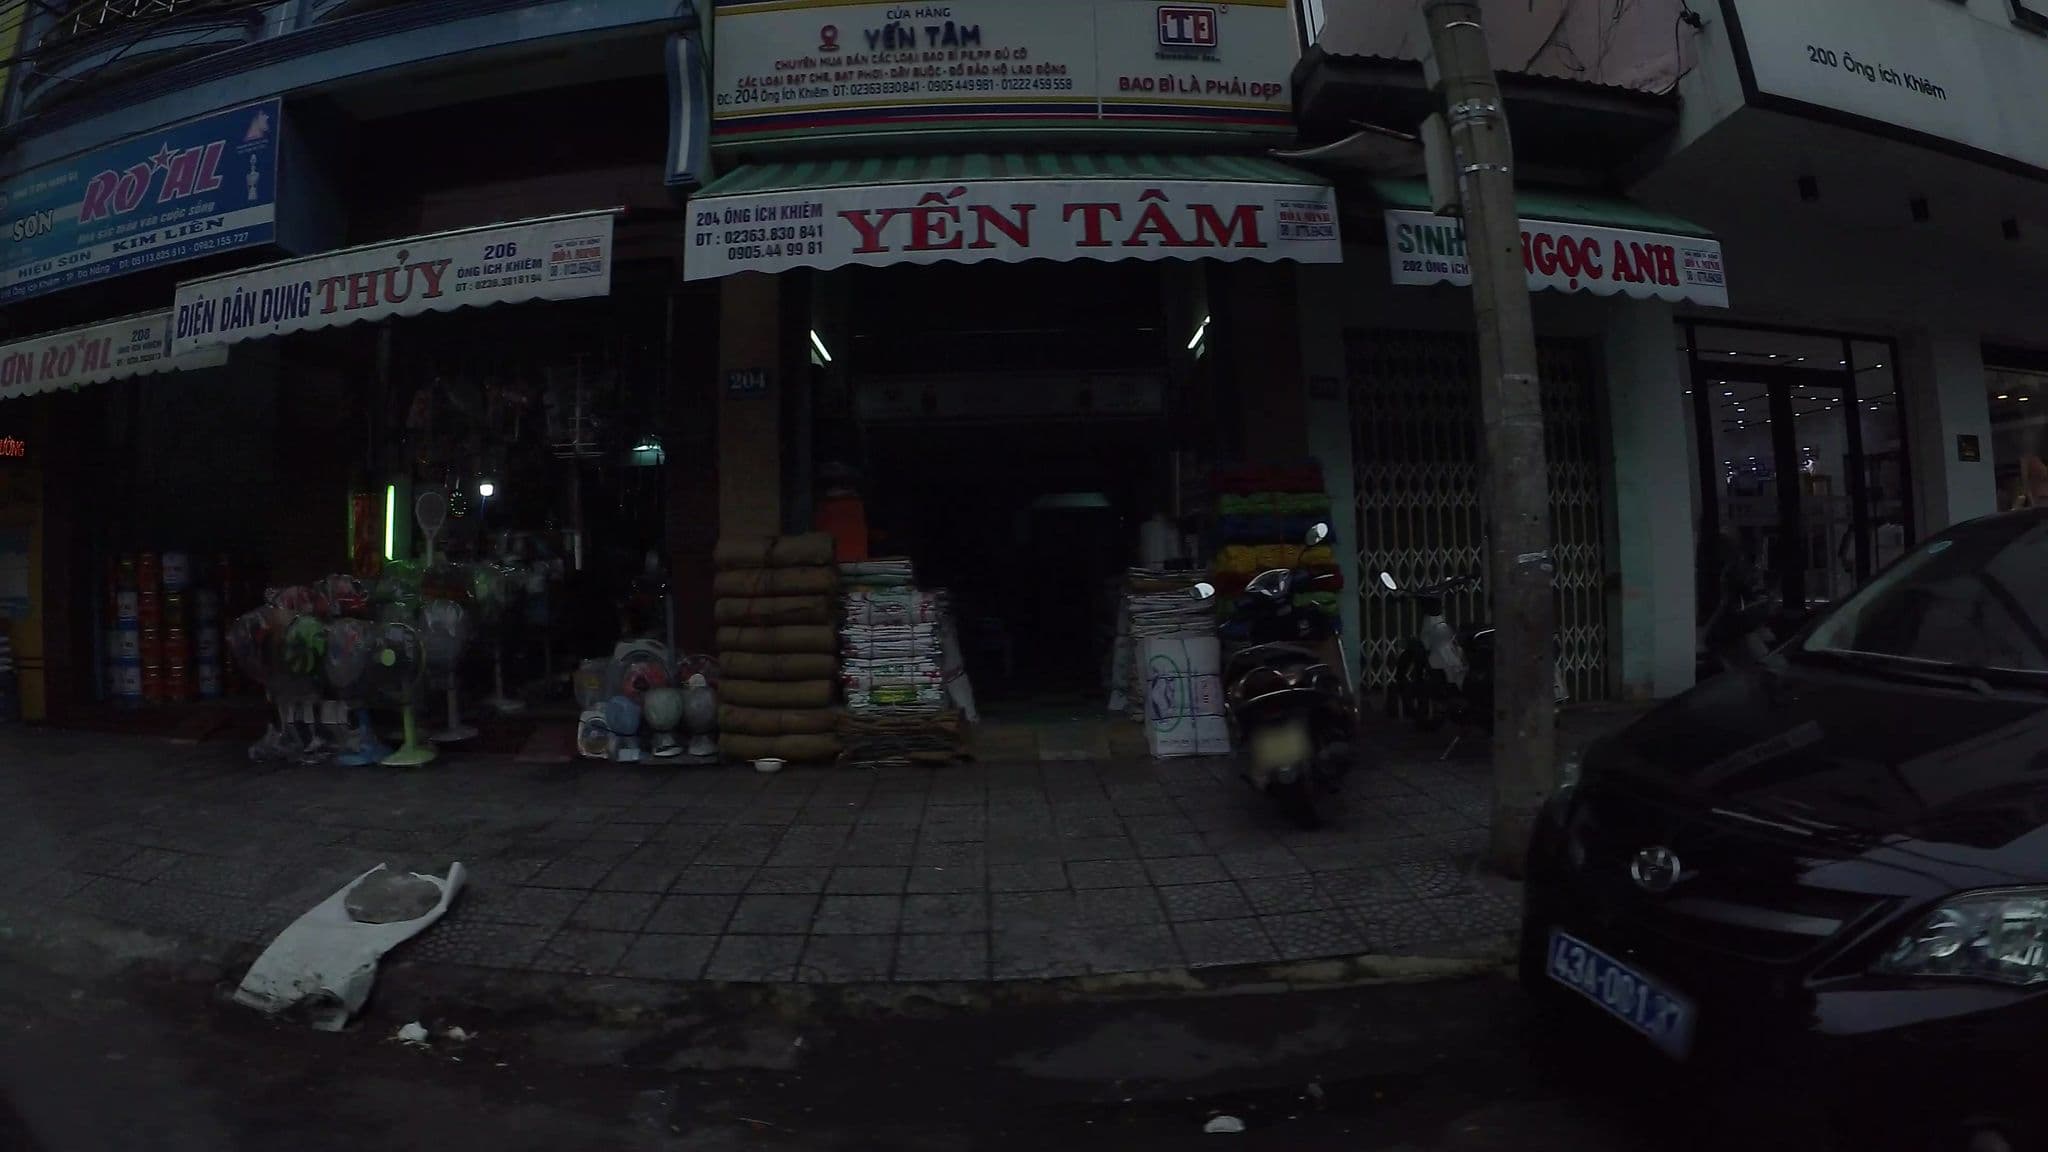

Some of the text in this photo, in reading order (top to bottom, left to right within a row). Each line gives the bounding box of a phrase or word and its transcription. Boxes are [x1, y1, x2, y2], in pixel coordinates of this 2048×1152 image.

[887, 6, 950, 20] CỬA HÀNG
[864, 19, 981, 51] YẾN TÂM
[775, 55, 817, 71] CHUYÊN
[820, 54, 842, 67] MUA
[846, 51, 869, 66] BÁN
[872, 49, 892, 64] CÁC
[894, 51, 919, 65] LOẠI
[922, 50, 943, 62] BAO
[1807, 45, 1838, 67] 200
[1843, 52, 1876, 82] Ông
[1903, 73, 1947, 100] Khiêm
[738, 74, 758, 88] CÁC
[759, 74, 784, 87] LOẠI
[1011, 64, 1032, 75] LAO
[1036, 61, 1067, 76] ĐỘNG
[1119, 74, 1282, 101] BAO BÌ LÀ PHẢI ĐẸP
[734, 87, 759, 104] 204
[798, 86, 830, 99] Khiêm
[11, 208, 55, 242] SƠN
[696, 200, 824, 226] 204 ÔNG ÍCH KHIÊM
[837, 186, 1268, 255] YẾN TÂM
[112, 232, 157, 253] KIM
[164, 216, 225, 240] LIÊN
[799, 224, 824, 239] 841
[483, 242, 518, 261] 206
[786, 242, 803, 257] 99
[808, 242, 824, 255] 81
[1398, 223, 1465, 257] SINH
[1612, 239, 1680, 287] ANH
[456, 265, 481, 279] ÔNG
[504, 258, 543, 274] KHIÊM
[1402, 259, 1423, 272] 202
[176, 294, 217, 344] ĐIỆN
[220, 286, 258, 332] DÂN
[260, 280, 312, 331] DỤNG
[317, 249, 453, 315] THỦY
[0, 351, 34, 388] ƠN
[729, 372, 767, 389] 204
